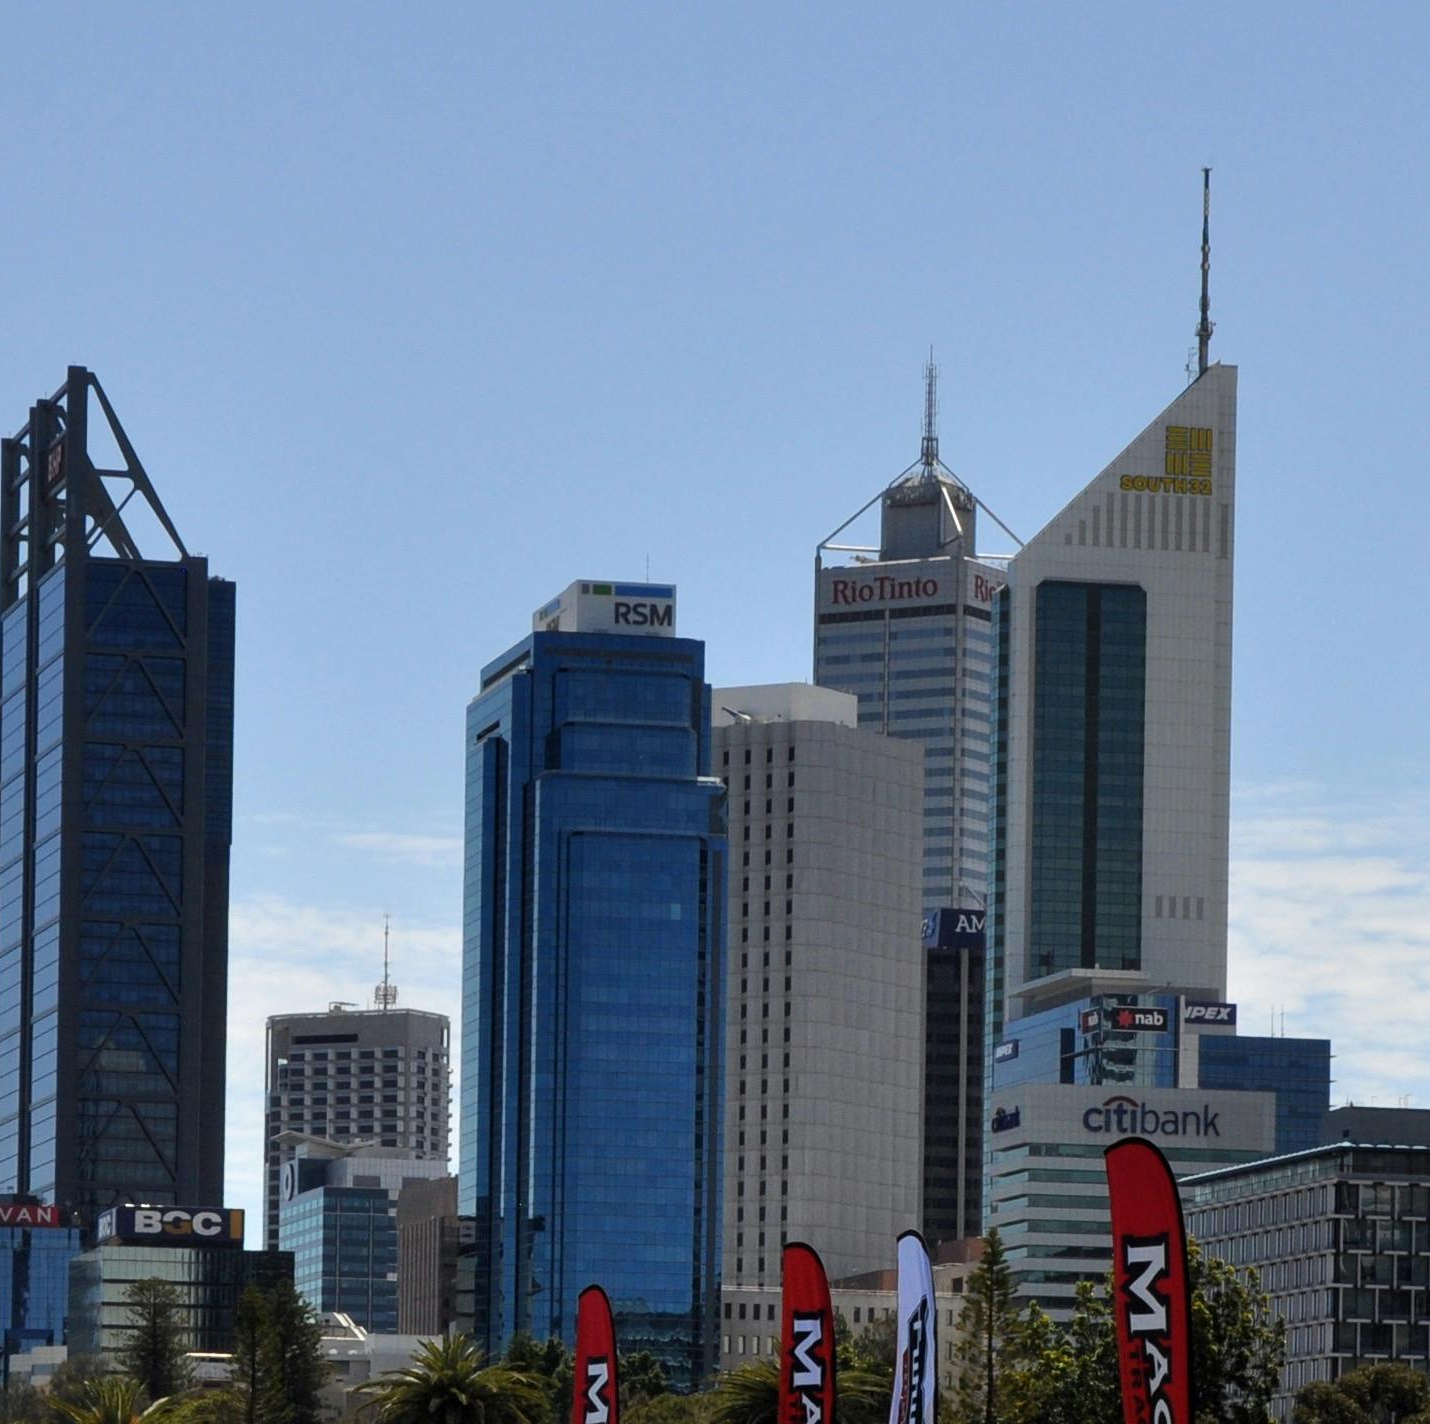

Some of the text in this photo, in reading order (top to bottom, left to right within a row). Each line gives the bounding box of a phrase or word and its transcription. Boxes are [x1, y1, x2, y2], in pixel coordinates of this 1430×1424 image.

[1119, 474, 1213, 496] SOUTH32
[614, 602, 672, 627] RSM
[1135, 1011, 1164, 1026] nab
[1082, 1098, 1221, 1137] citibank
[134, 1210, 223, 1236] BGC
